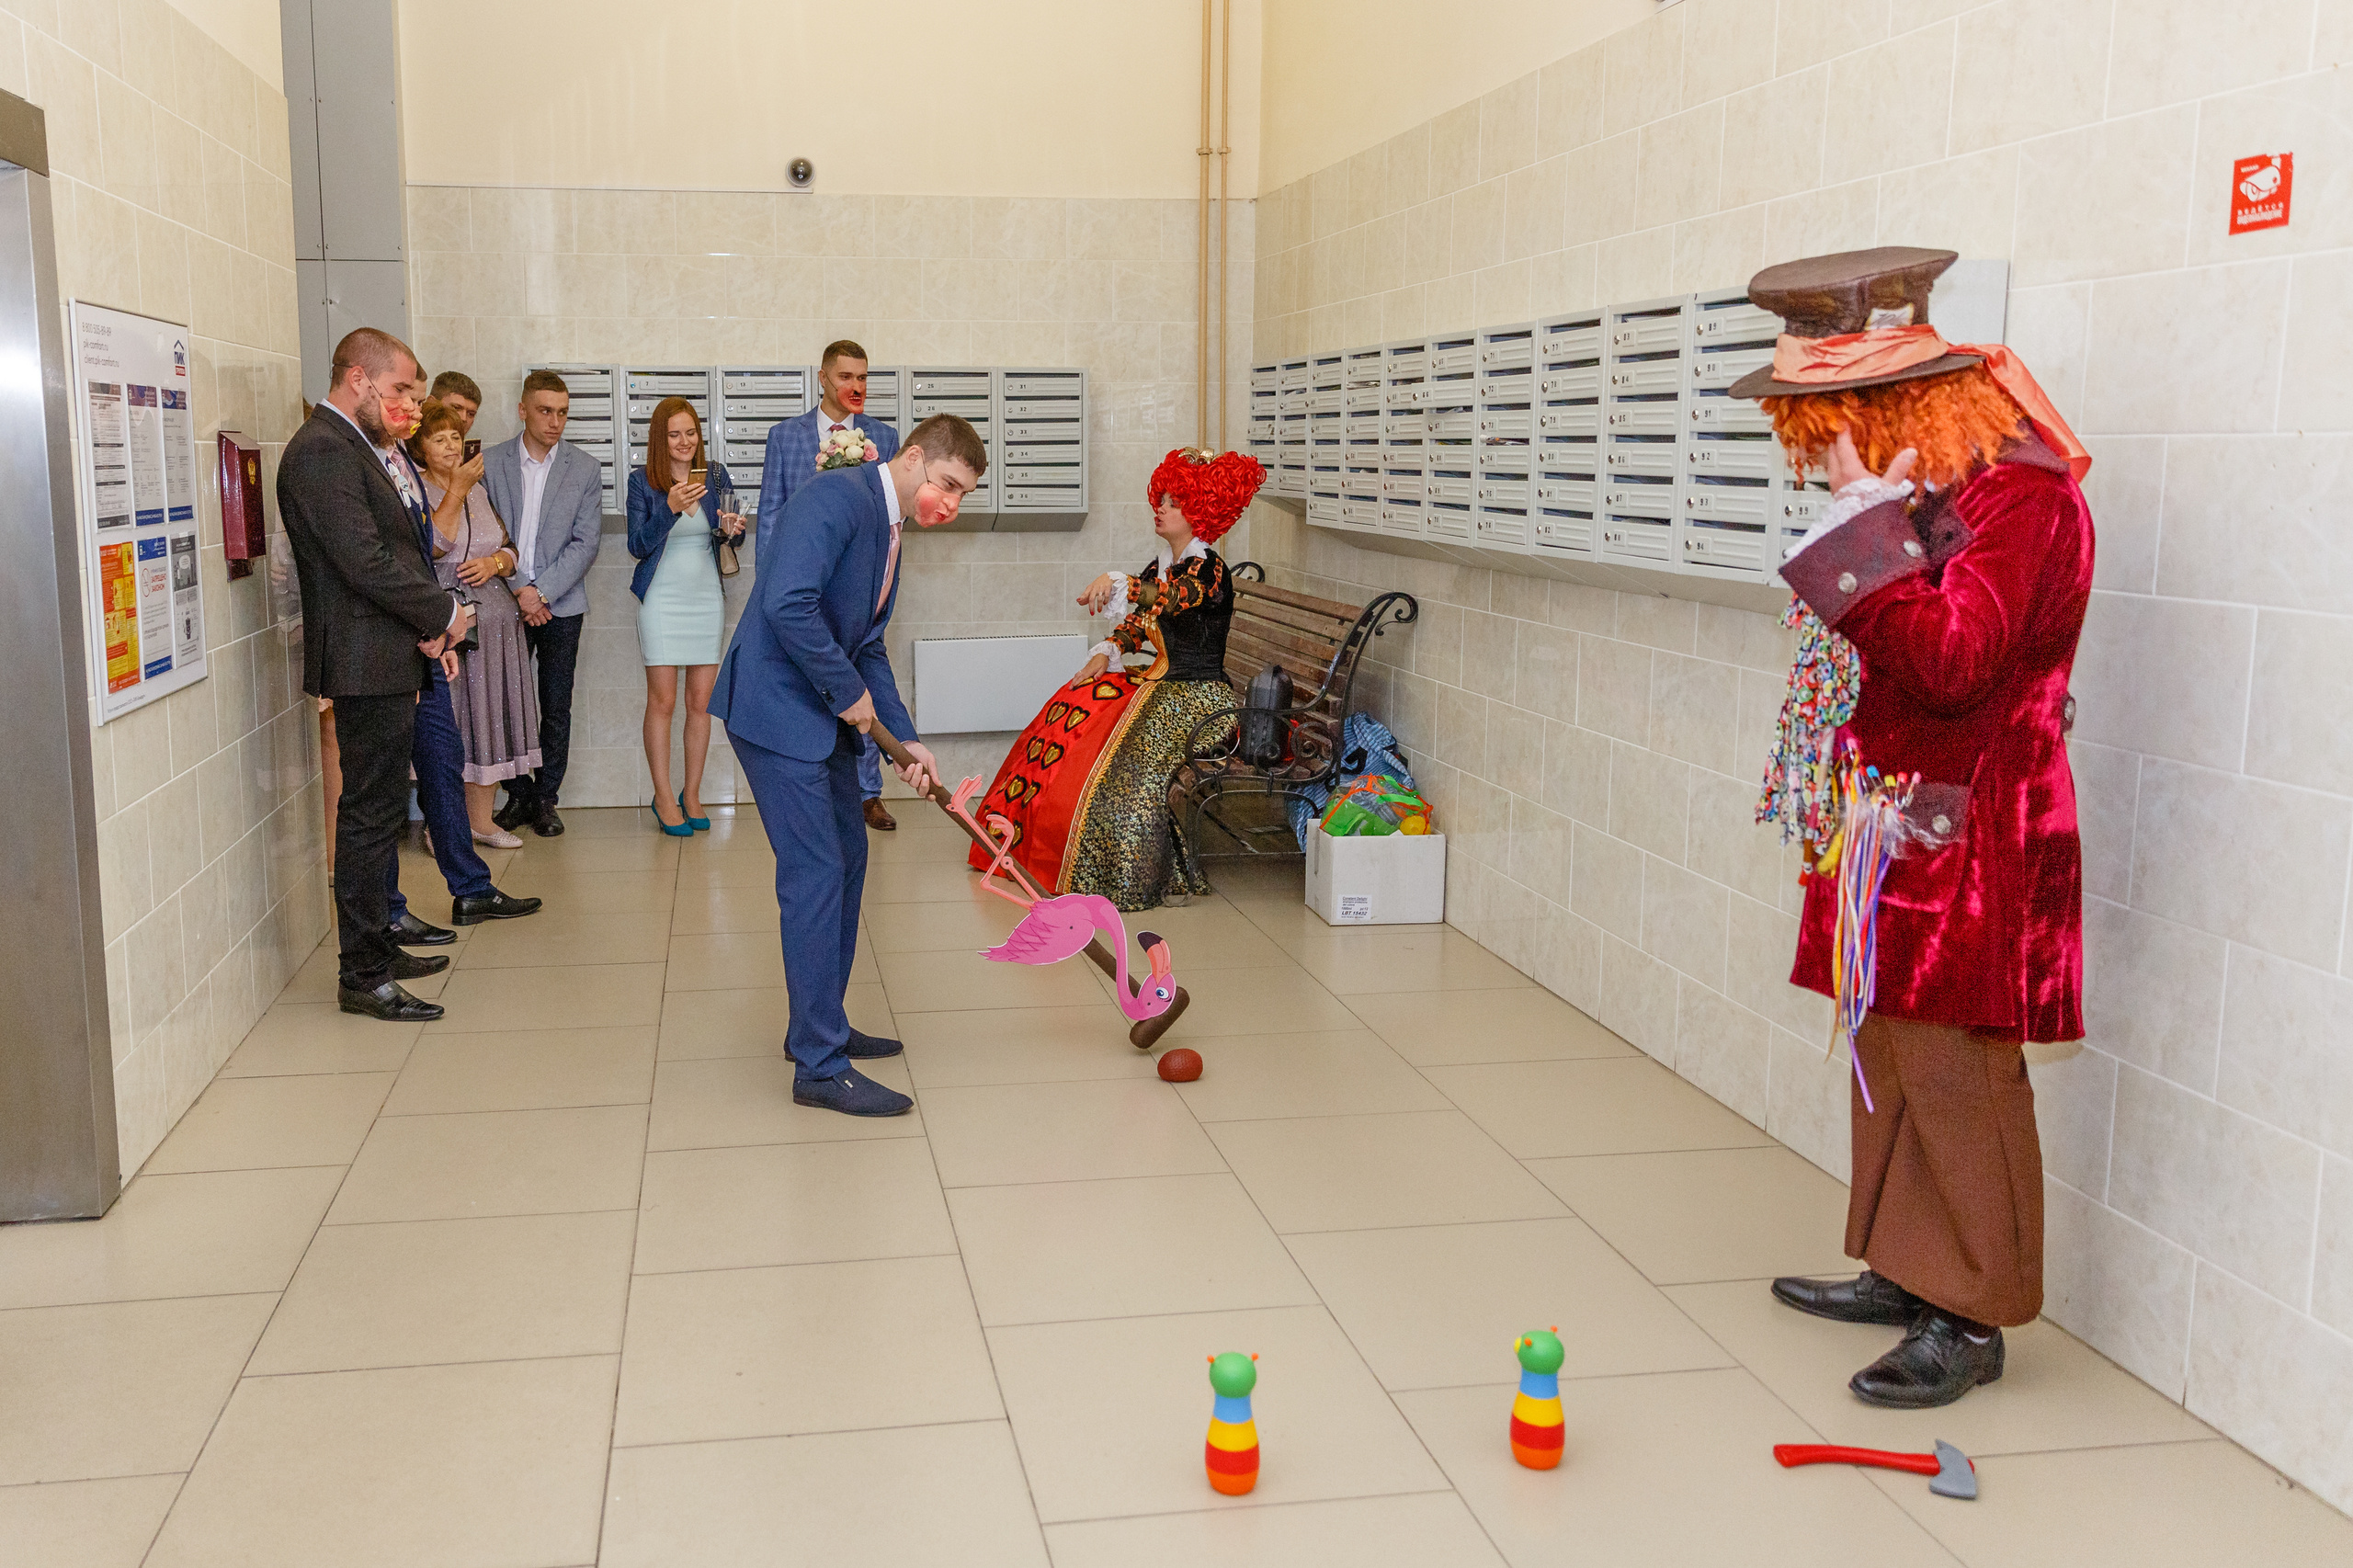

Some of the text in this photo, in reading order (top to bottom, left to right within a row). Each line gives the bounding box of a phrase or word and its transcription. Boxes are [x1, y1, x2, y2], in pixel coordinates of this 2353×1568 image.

[1709, 323, 1717, 331] 89
[1623, 333, 1631, 341] 83
[174, 351, 185, 365] ПИК
[1707, 363, 1715, 371] 90
[1620, 415, 1626, 423] 85
[1701, 452, 1710, 460] 92
[1700, 498, 1708, 506] 93
[1799, 506, 1808, 515] 99
